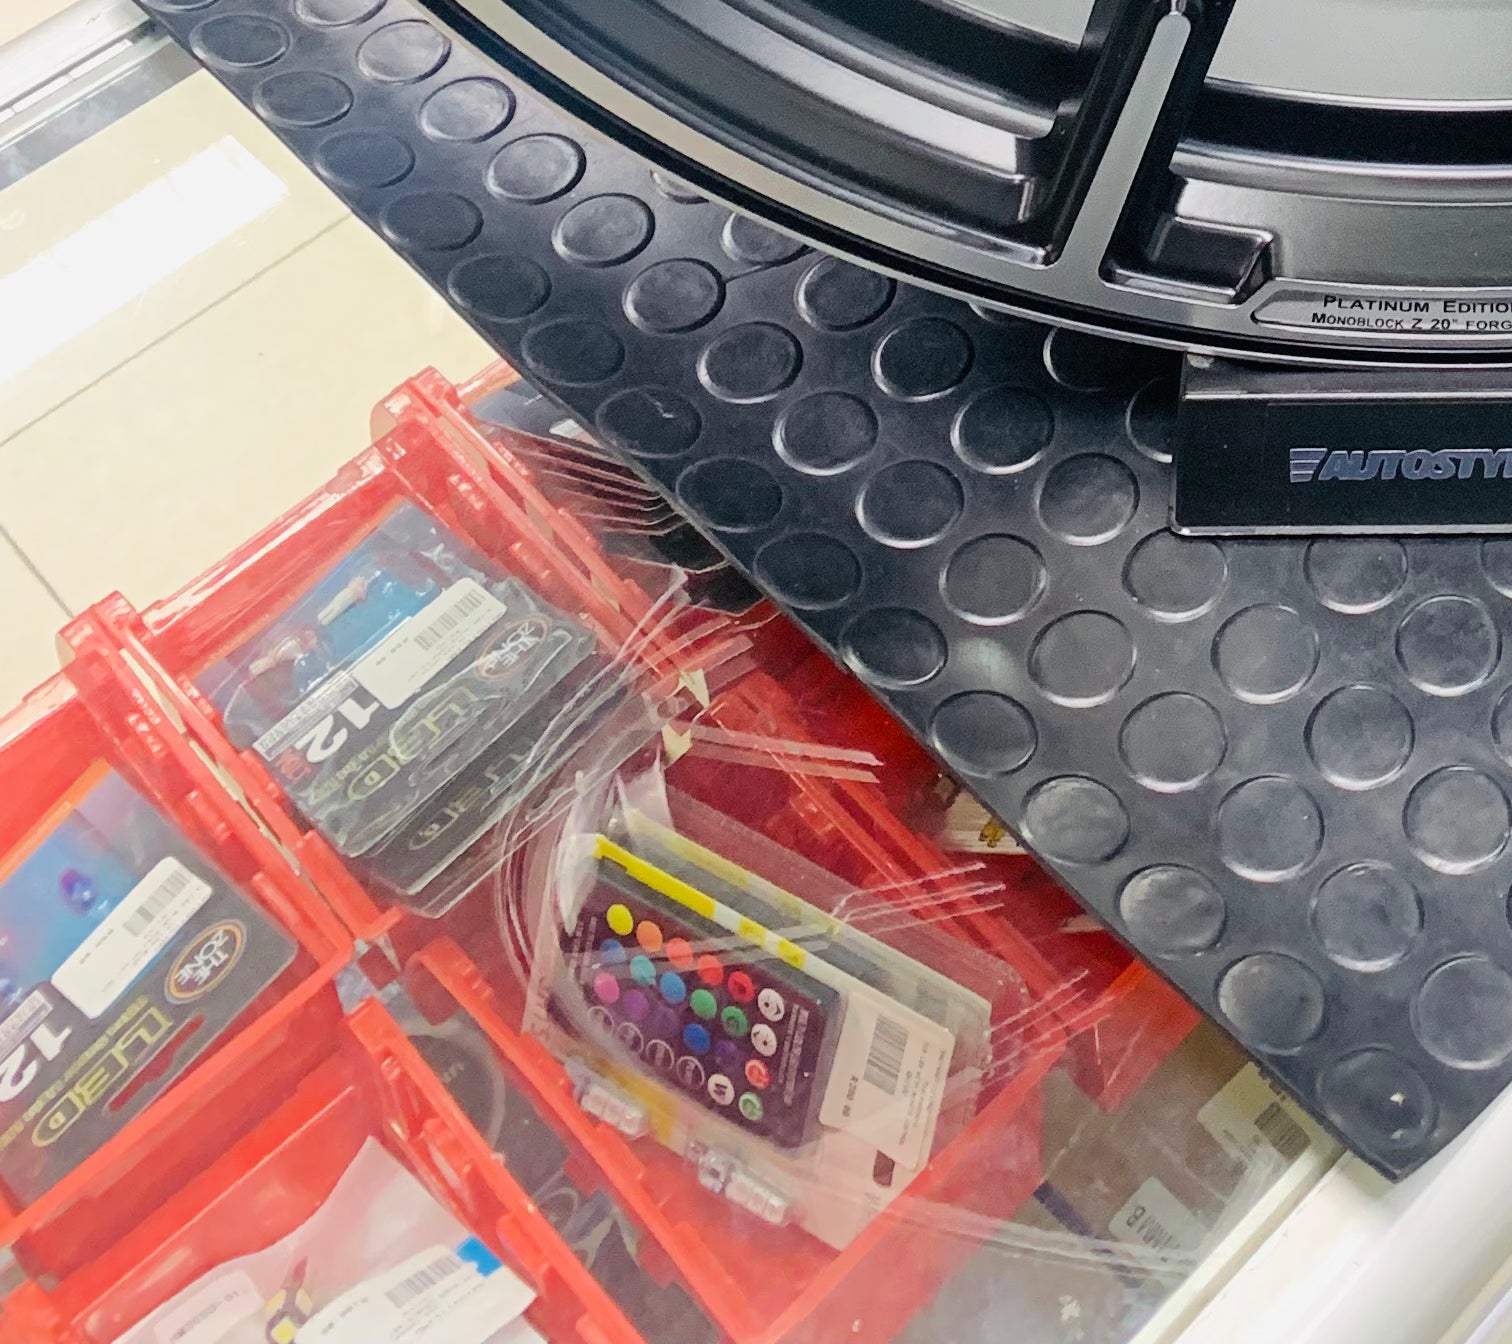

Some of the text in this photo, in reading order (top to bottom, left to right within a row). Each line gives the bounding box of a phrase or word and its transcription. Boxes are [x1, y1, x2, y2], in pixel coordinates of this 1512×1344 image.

[293, 693, 381, 763] 12
[174, 928, 230, 986] ZONE
[191, 949, 230, 987] THE
[31, 1005, 174, 1147] LED
